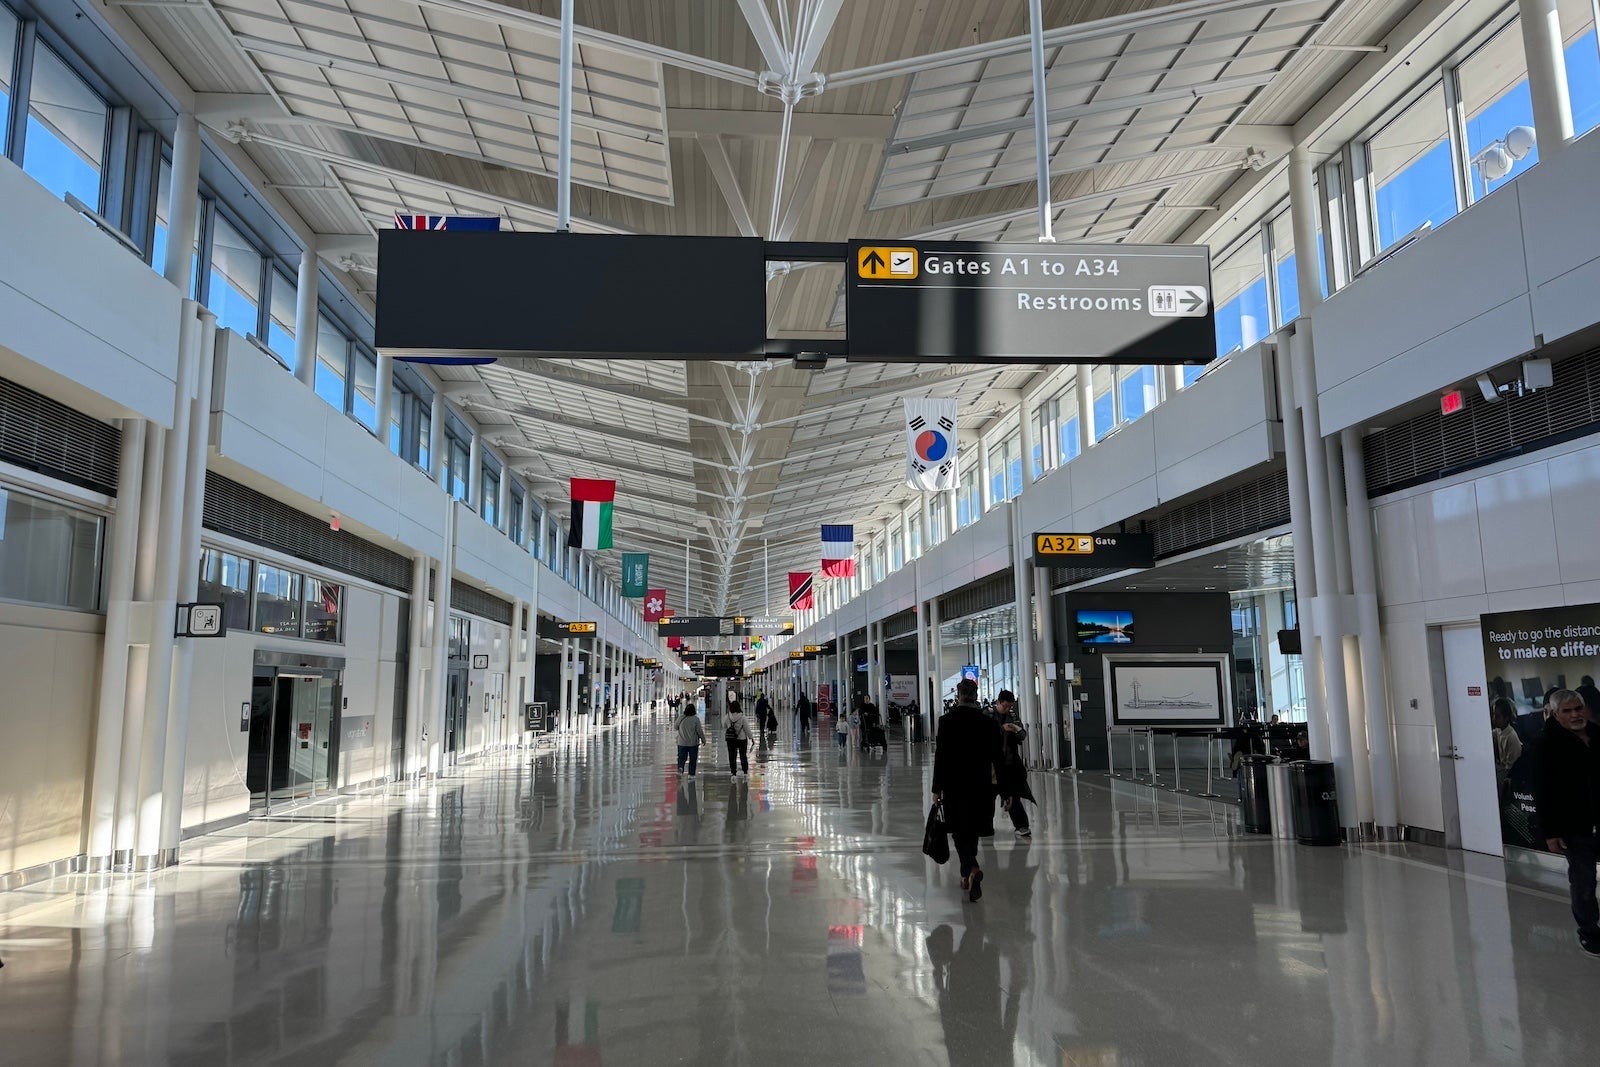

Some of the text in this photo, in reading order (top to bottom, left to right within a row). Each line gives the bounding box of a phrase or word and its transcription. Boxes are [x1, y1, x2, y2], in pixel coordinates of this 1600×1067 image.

[924, 256, 1120, 277] Gates A1 to A34
[1017, 293, 1142, 311] Restrooms
[1041, 537, 1117, 551] A32 Gate
[1489, 630, 1516, 644] Ready
[1518, 629, 1529, 640] to
[1530, 630, 1543, 643] go
[1545, 627, 1561, 638] the
[1498, 641, 1600, 659] to make a differ
[1513, 791, 1534, 802] Volunt
[1521, 798, 1536, 813] Peac
